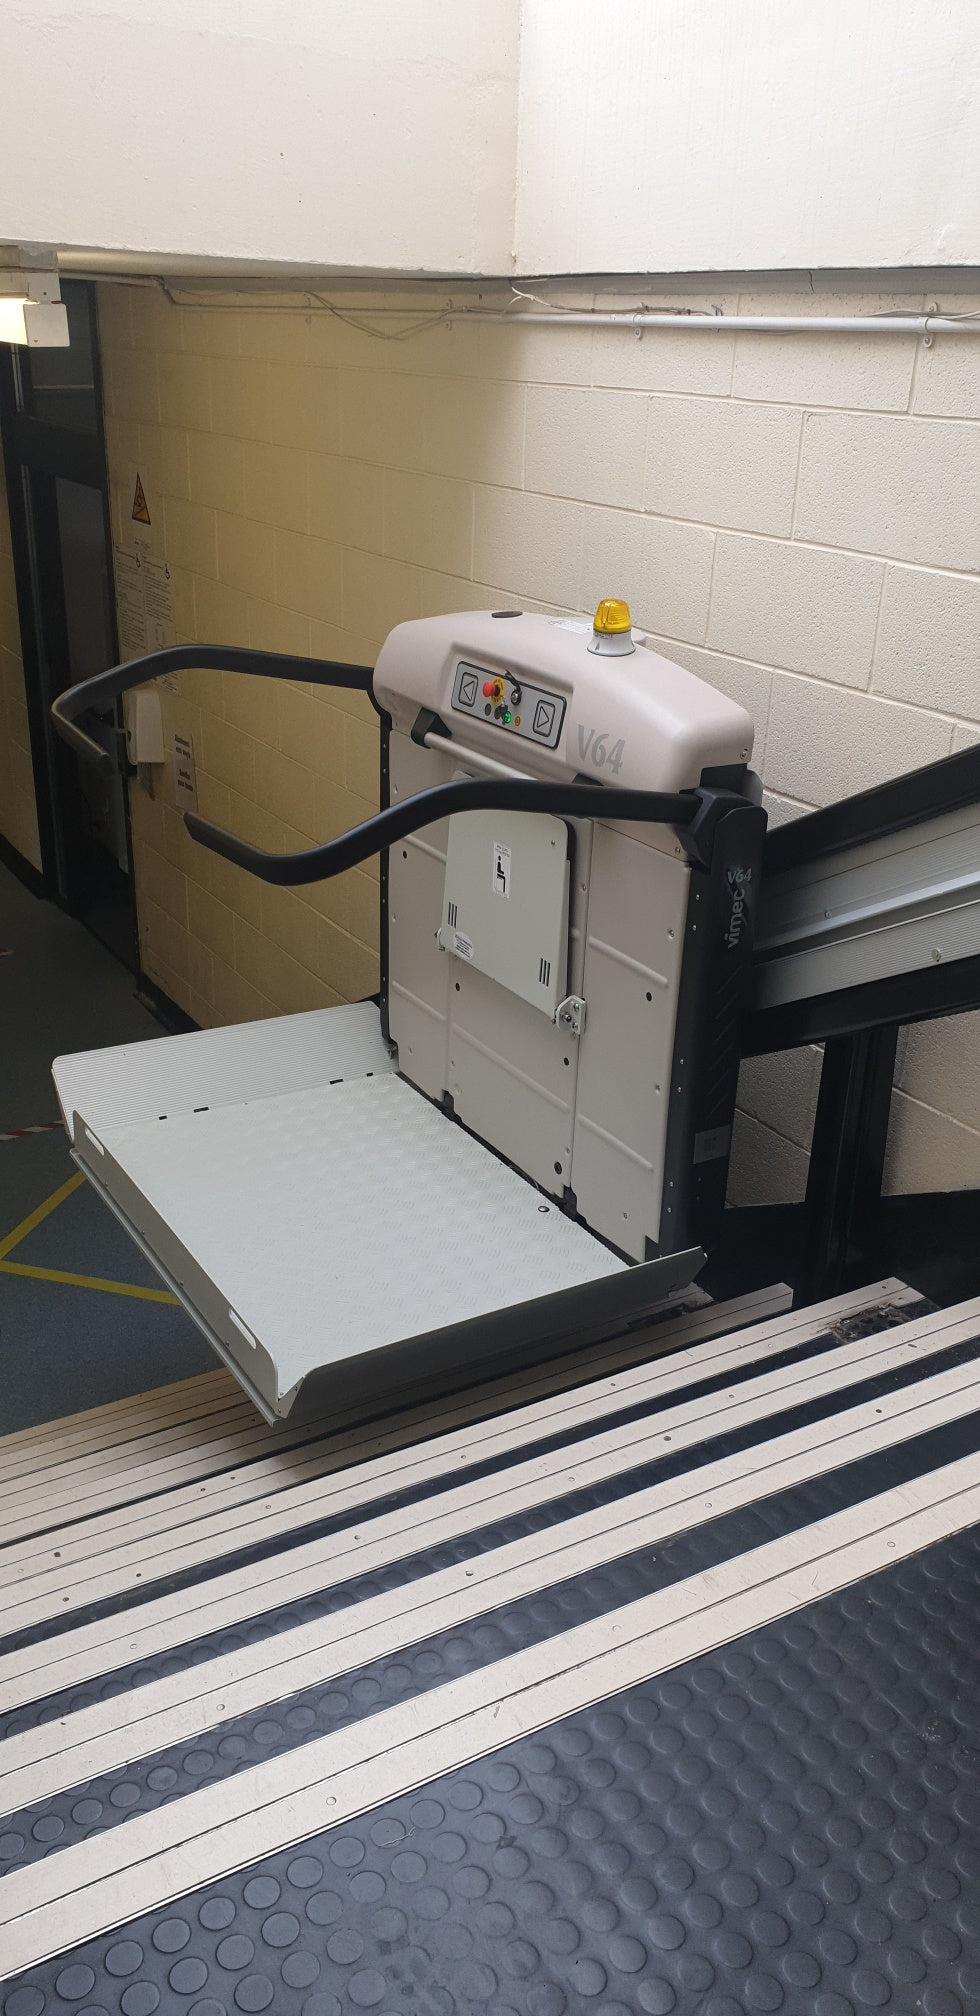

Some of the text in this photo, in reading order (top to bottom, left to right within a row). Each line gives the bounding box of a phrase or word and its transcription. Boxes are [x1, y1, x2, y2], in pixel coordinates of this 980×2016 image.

[578, 724, 625, 775] V64
[727, 868, 752, 884] V64
[724, 888, 745, 949] vimec
